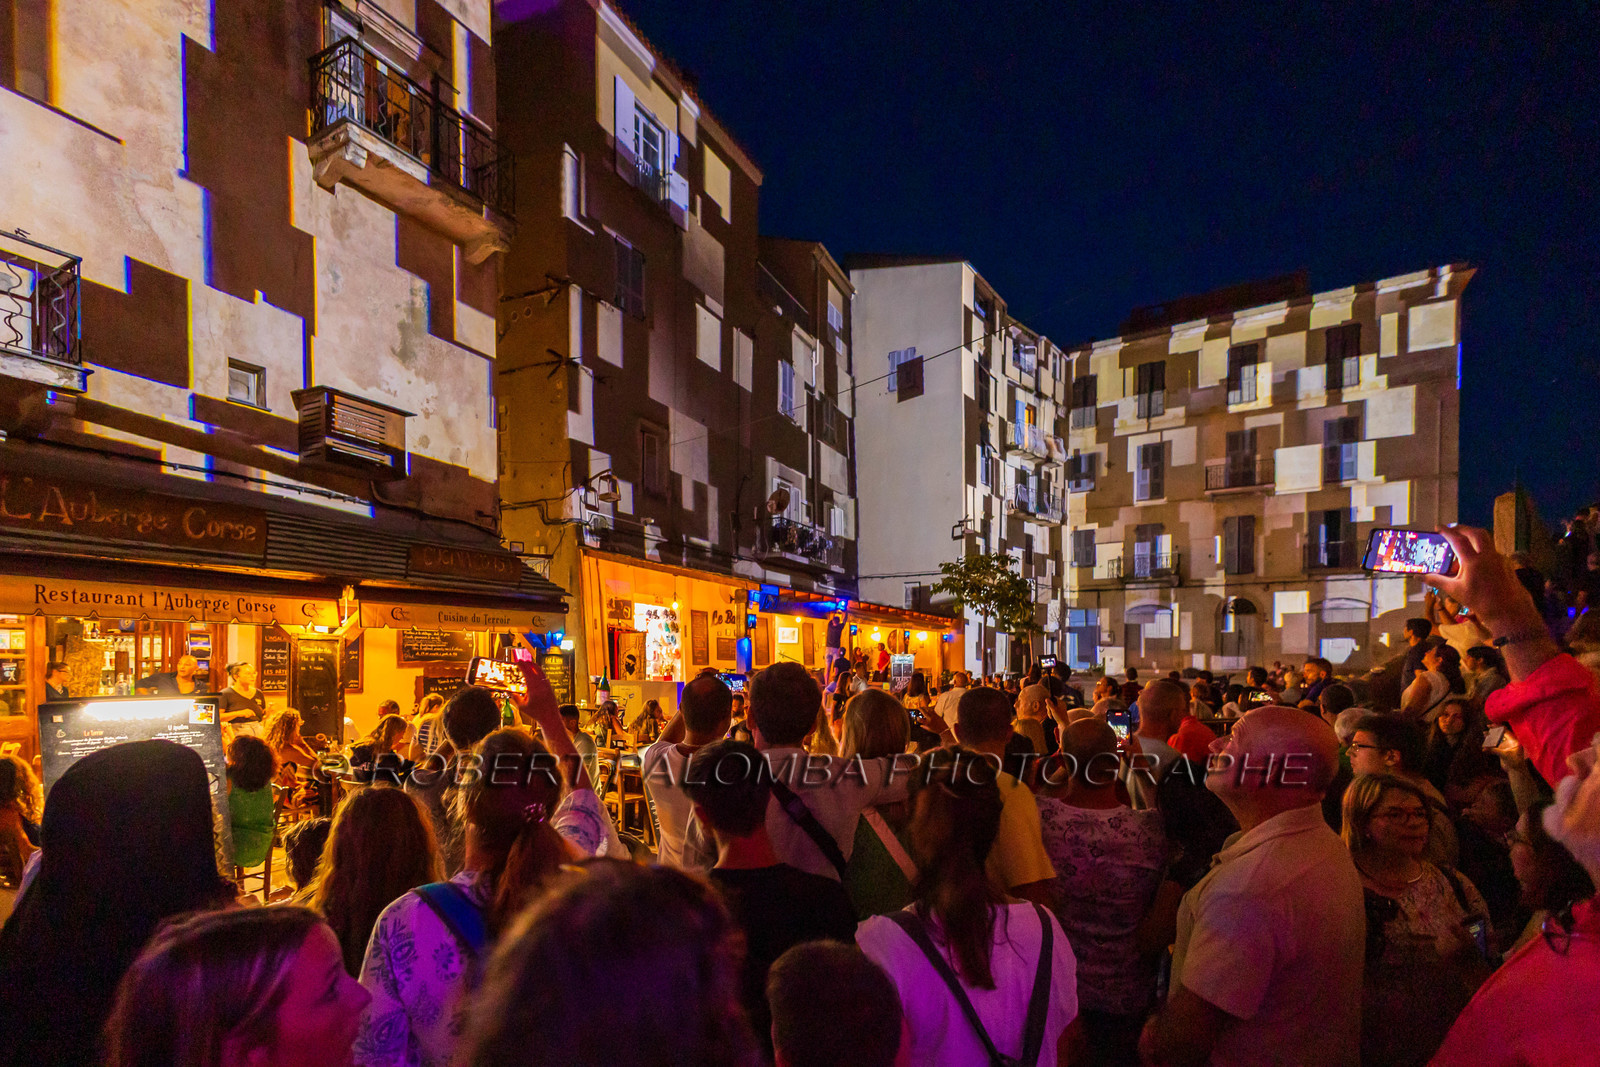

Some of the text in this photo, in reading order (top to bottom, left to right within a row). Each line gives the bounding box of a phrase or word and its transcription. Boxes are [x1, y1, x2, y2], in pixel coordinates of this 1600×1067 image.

[182, 506, 257, 542] Corse
[34, 583, 146, 608] Restaurant
[152, 591, 230, 613] l'Auberge
[236, 597, 277, 614] Corse
[438, 610, 511, 626] Cuisine du Terroir
[711, 609, 735, 627] Le Ba
